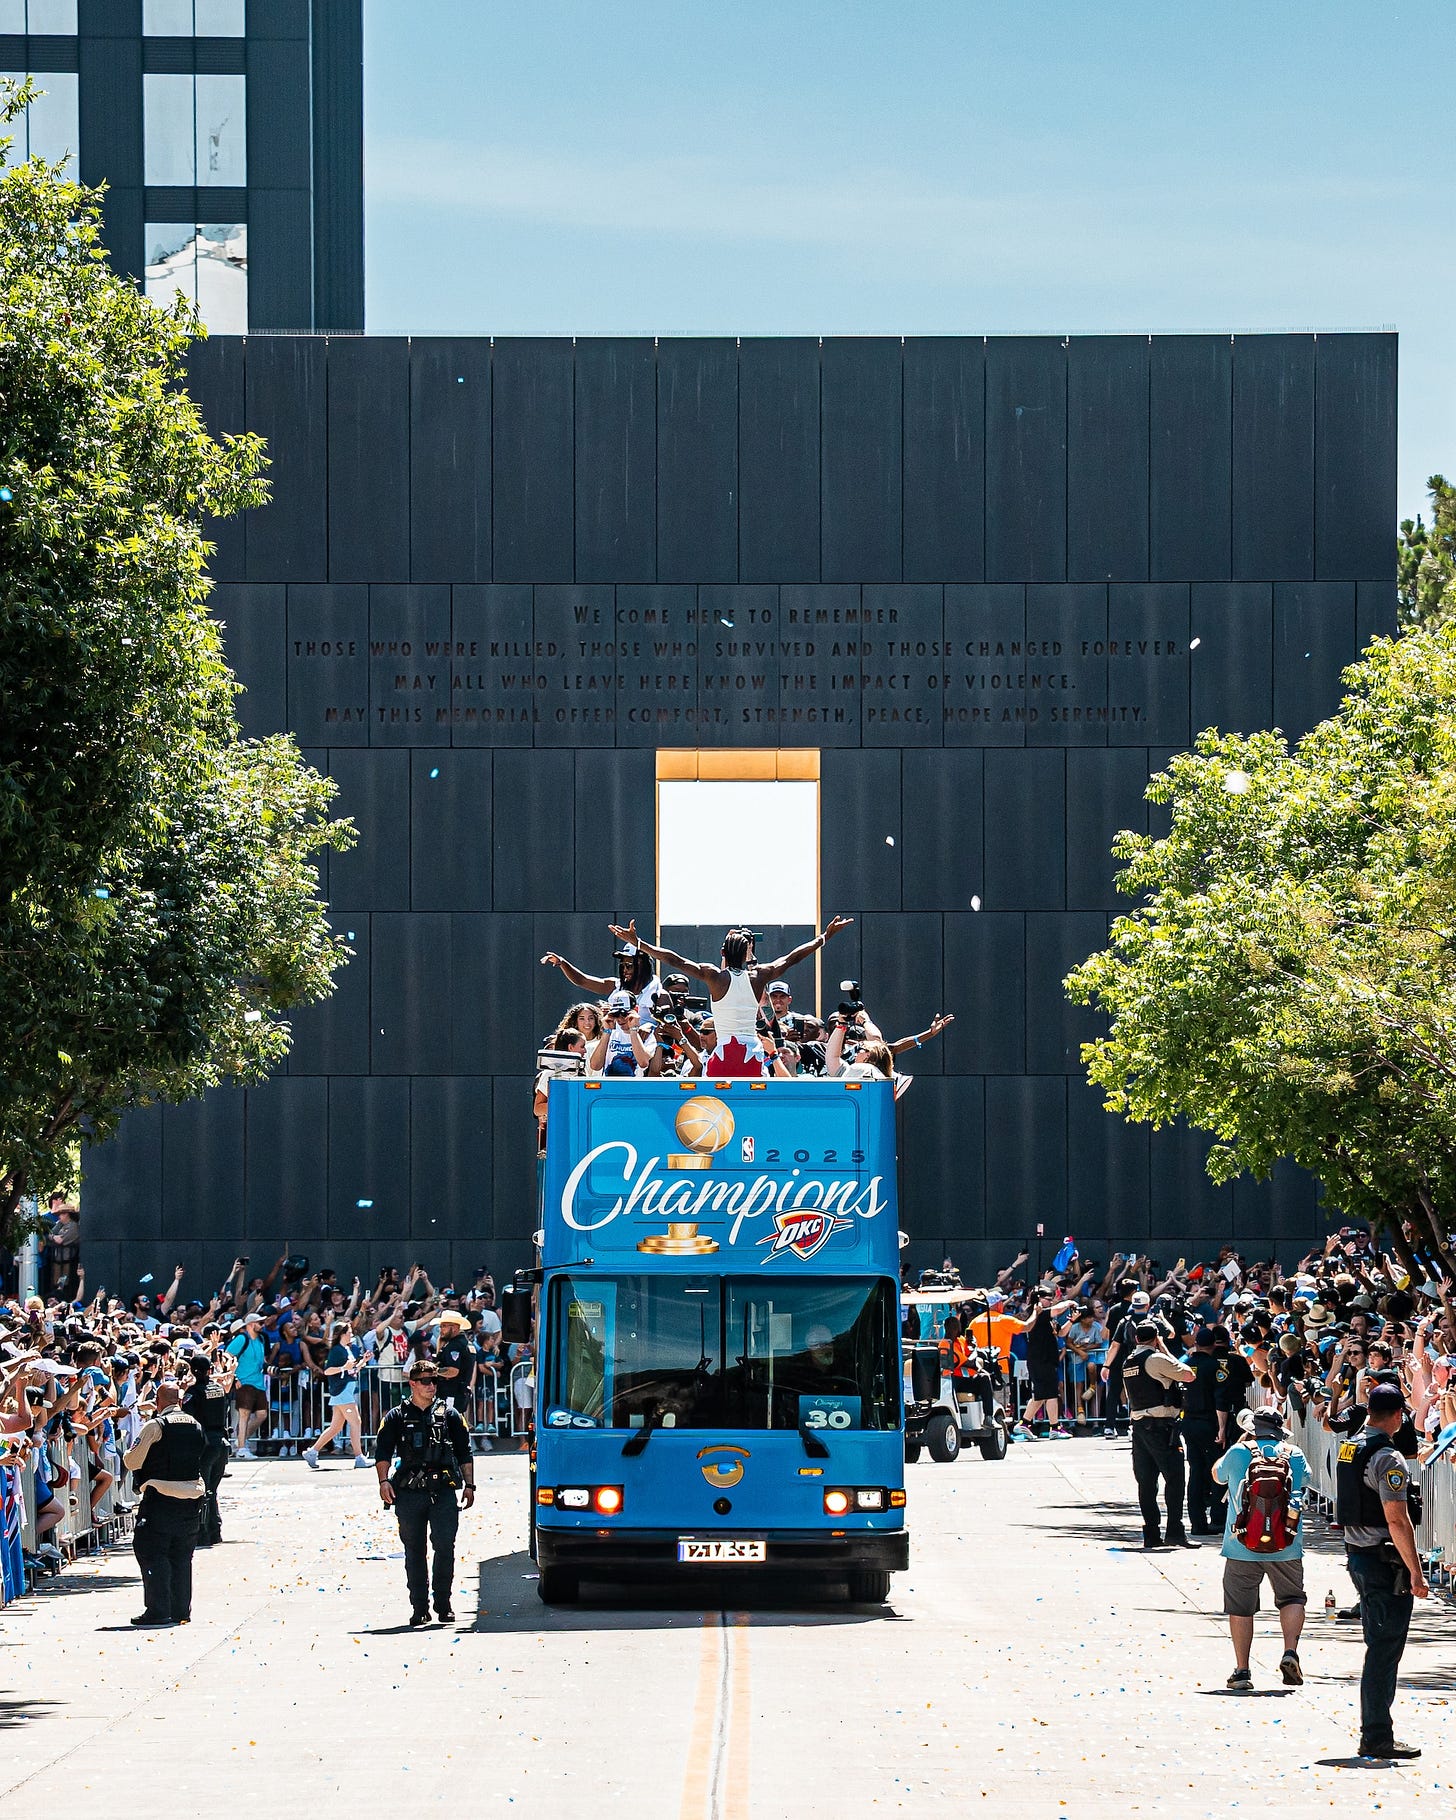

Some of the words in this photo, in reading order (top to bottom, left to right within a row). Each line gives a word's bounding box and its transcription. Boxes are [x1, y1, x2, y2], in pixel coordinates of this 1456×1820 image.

[617, 609, 669, 624] COME
[686, 609, 735, 624] HERE
[749, 609, 772, 624] TO
[789, 609, 899, 624] REMEMBER
[294, 641, 357, 657] THOSE
[370, 641, 413, 657] WHO
[425, 641, 478, 657] WERE
[490, 641, 566, 659] KILLED,
[579, 641, 641, 657] THOSE
[654, 641, 698, 657] WHO
[715, 641, 816, 657] SURVIVED
[831, 641, 873, 657] AND
[887, 641, 953, 657] THOSE
[965, 641, 1063, 657] CHANGED
[1081, 641, 1183, 657] FOREVER.
[394, 674, 437, 690] MAY
[452, 674, 486, 690] ALL
[501, 674, 548, 690] WHO
[563, 674, 625, 690] LEAVE
[639, 674, 690, 690] HERE
[705, 674, 766, 690] KNOW
[780, 674, 818, 690] THE
[831, 674, 911, 690] IMPACT
[927, 674, 952, 690] OF
[965, 674, 1076, 690] VIOLENCE.
[325, 707, 366, 723] MAY
[378, 707, 422, 723] THIS
[435, 707, 540, 723] MEMORIAL
[556, 707, 616, 723] OFFER
[628, 707, 728, 725] COMFORT,
[742, 707, 854, 725] STRENGTH,
[867, 707, 931, 725] PEACE,
[943, 707, 991, 723] HOPE
[1001, 707, 1039, 723] AND
[1050, 707, 1147, 723] SERENITY.
[766, 1149, 866, 1163] 2025
[561, 1141, 888, 1245] Champions
[774, 1218, 822, 1250] OKC
[805, 1410, 851, 1429] 30
